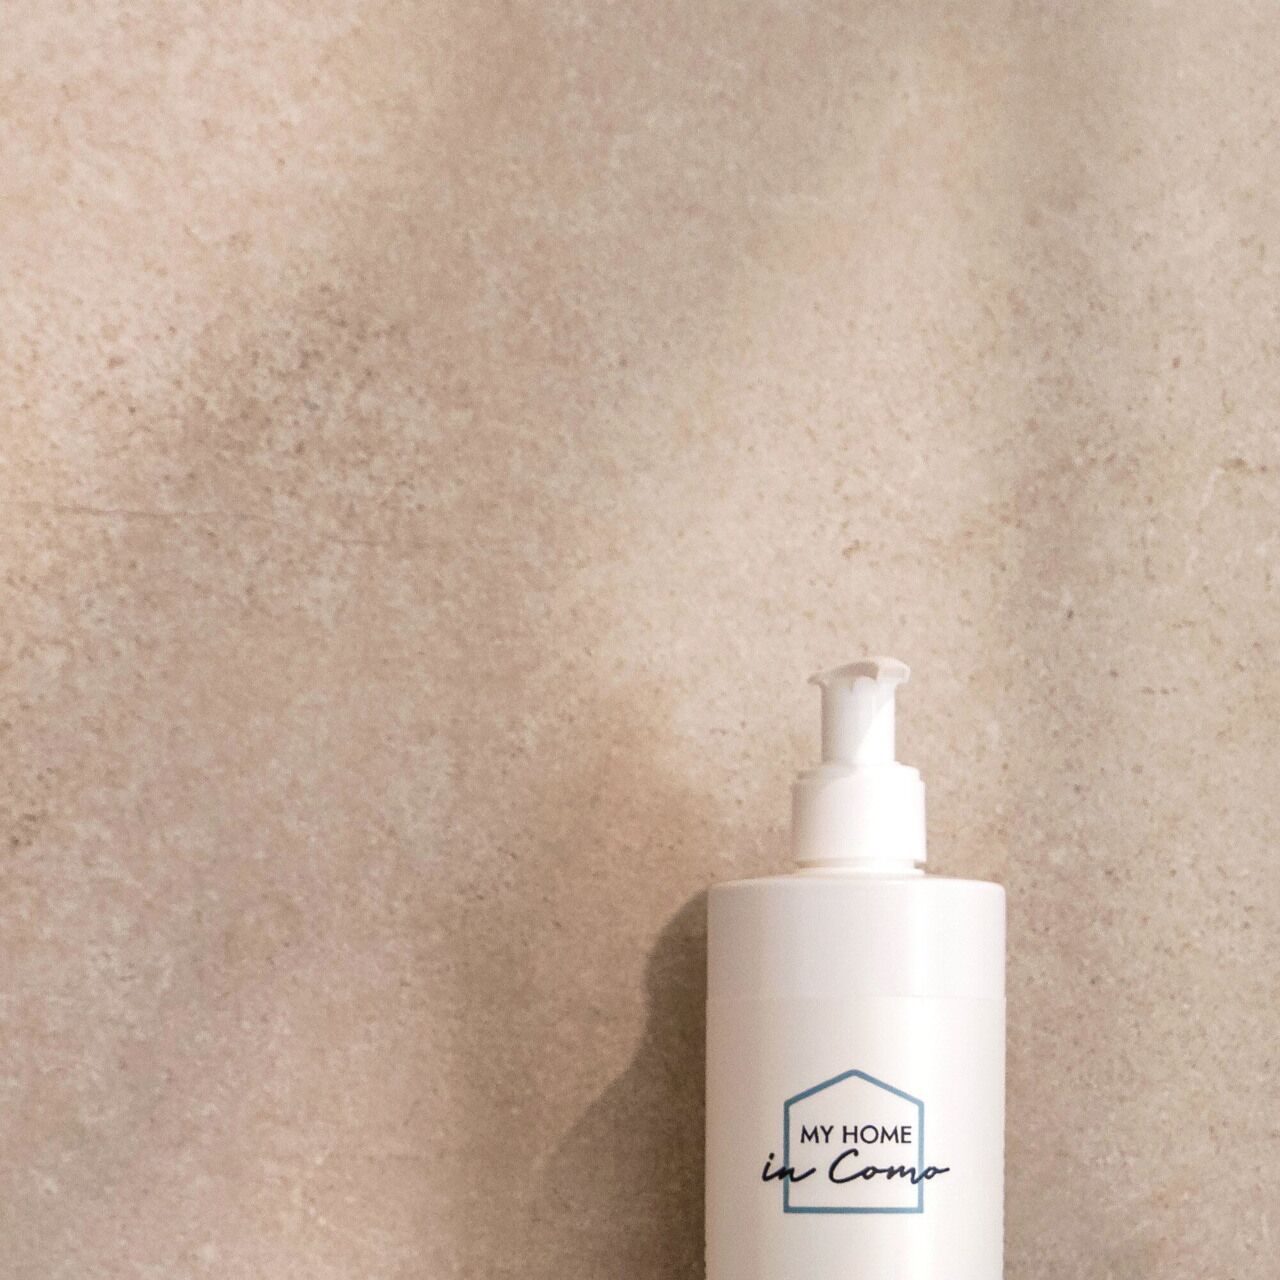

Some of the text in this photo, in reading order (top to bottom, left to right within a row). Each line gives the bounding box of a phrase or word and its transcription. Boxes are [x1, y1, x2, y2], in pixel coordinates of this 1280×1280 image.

[800, 1125, 912, 1144] MY HOME
[761, 1148, 950, 1184] in Como
